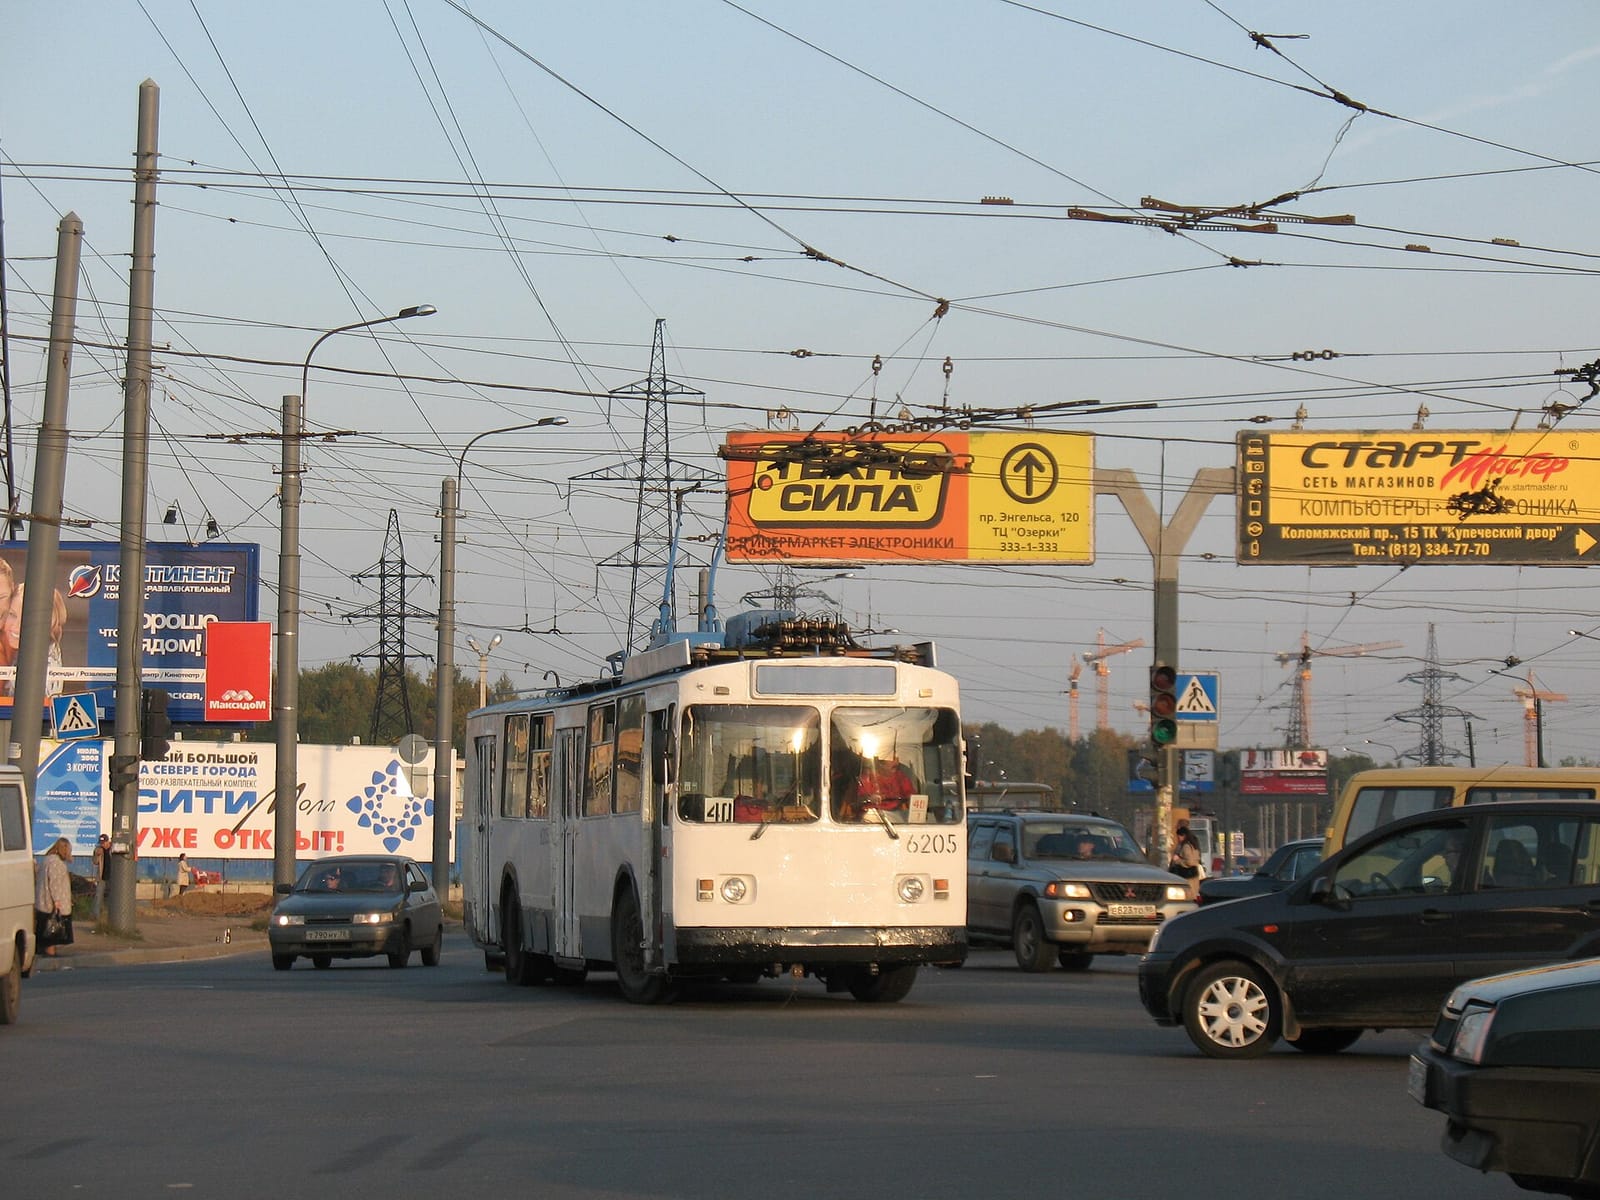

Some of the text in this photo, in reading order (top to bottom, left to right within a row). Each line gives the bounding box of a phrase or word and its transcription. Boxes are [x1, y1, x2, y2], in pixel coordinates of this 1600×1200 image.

[1303, 476, 1435, 488] СЕТЬ МАГАЗИНОВ
[780, 484, 918, 512] СИЛА
[1301, 499, 1431, 516] КОМПЬЮТЕРЫ
[979, 512, 1079, 524] пр. Энгельса, 120
[992, 527, 1066, 539] ТЦ "Озерки"
[1281, 526, 1562, 541] Коломяжский пр., 15 ТК "Купеческий двор"
[849, 536, 954, 549] ЭЛЕКТРОНИКИ
[1000, 542, 1058, 552] 333-1-333
[1353, 543, 1490, 557] Тел.: (812) 334-77-70
[105, 564, 236, 584] КТИНЕНТ
[142, 633, 203, 657] ядом!
[187, 752, 258, 764] БОЛЬШОЙ
[73, 763, 99, 772] КОРПУС
[140, 765, 257, 777] А СЕВЕРЕ ГОРОДА
[224, 778, 257, 788] КОМПЛЕКС
[137, 789, 257, 814] СИТИ
[136, 827, 344, 852] УЖЕ ОТКЫТ!
[907, 834, 957, 854] 6205
